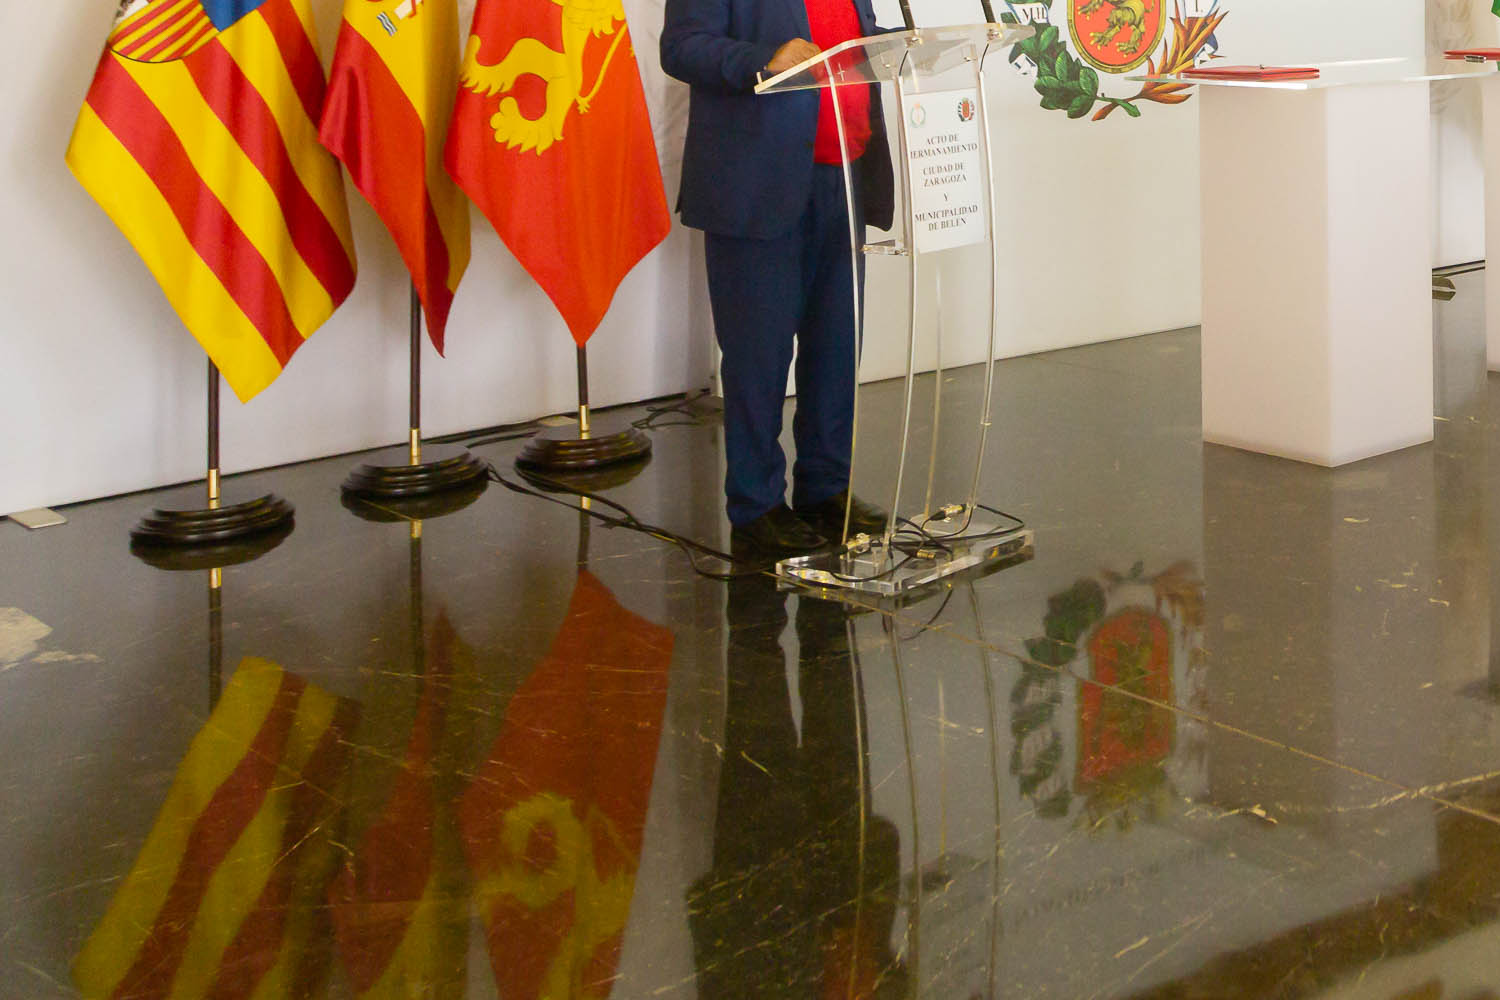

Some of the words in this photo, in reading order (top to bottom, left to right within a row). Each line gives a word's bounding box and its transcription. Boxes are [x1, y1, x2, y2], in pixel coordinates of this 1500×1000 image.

[926, 135, 946, 145] ACTO
[948, 134, 958, 143] DE
[923, 164, 953, 175] CIUDAD
[954, 162, 964, 171] DE
[923, 175, 967, 187] ZARAGOZA
[915, 205, 978, 221] MUNICIPALIDAD
[928, 221, 940, 231] DE
